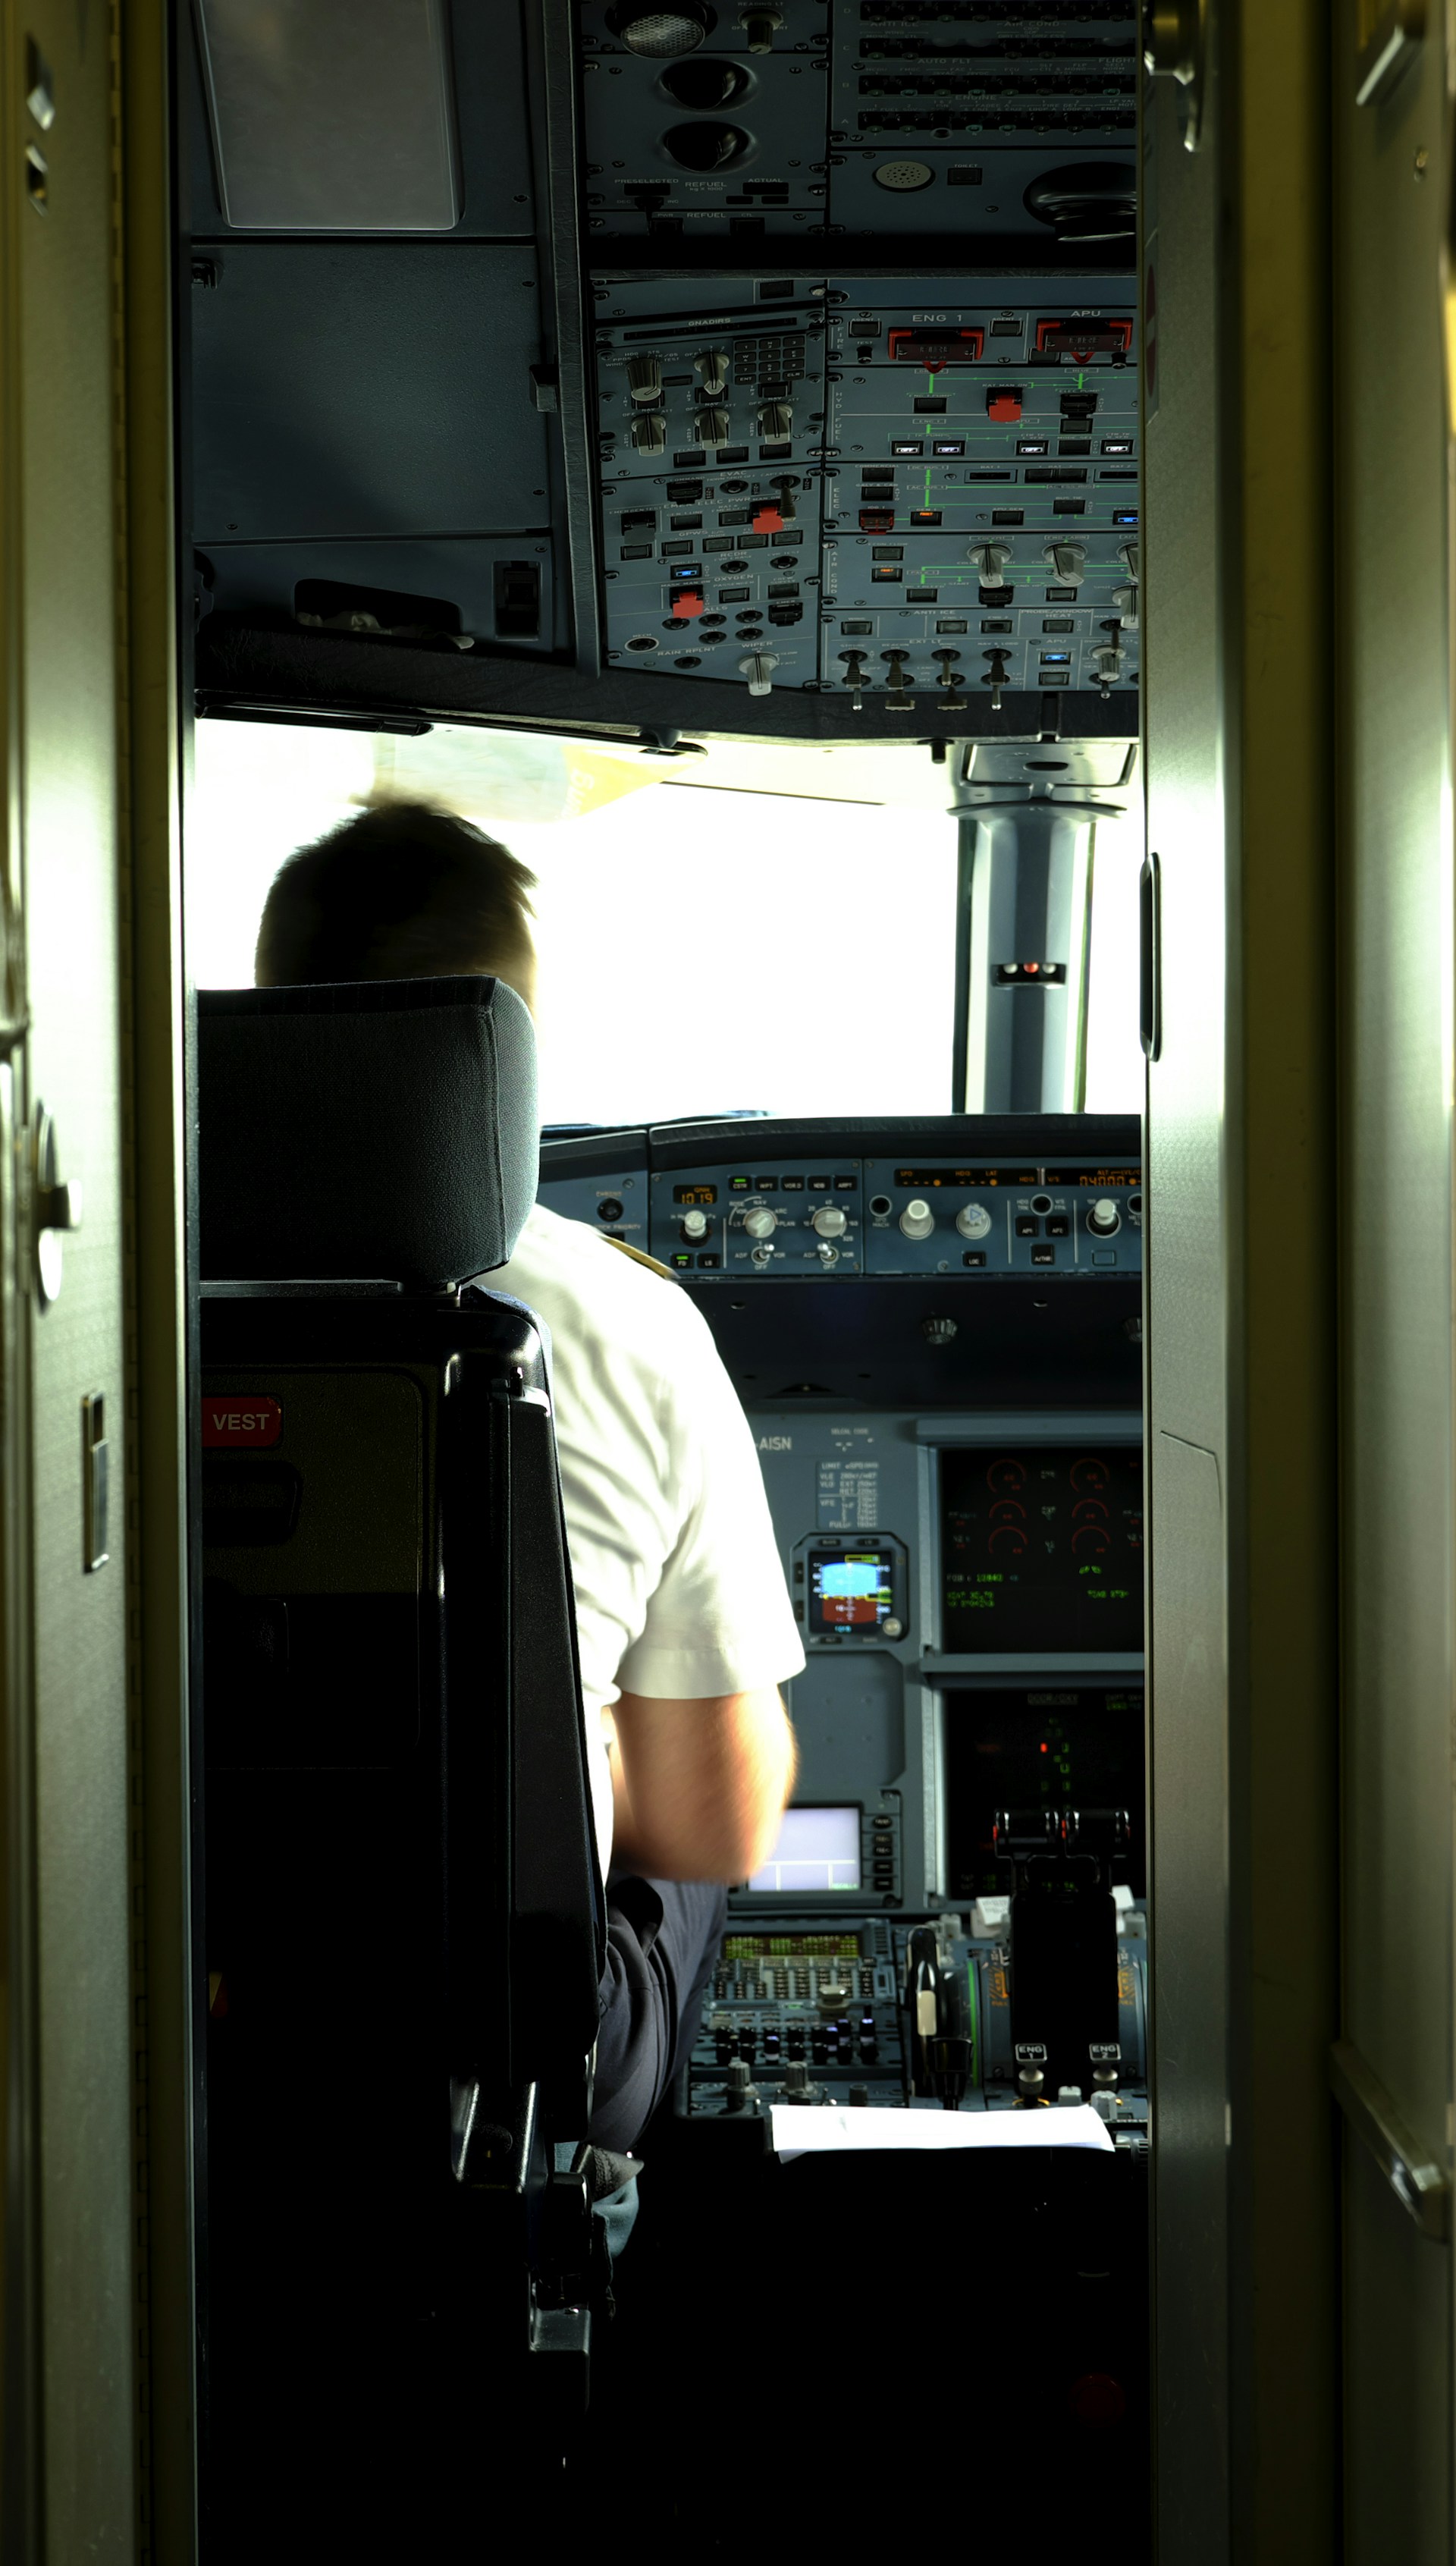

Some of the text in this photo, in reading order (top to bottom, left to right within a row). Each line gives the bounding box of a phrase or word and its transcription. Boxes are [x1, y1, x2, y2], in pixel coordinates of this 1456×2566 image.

[912, 314, 946, 322] ENG
[681, 1192, 714, 1204] 1019
[212, 1413, 270, 1431] VEST
